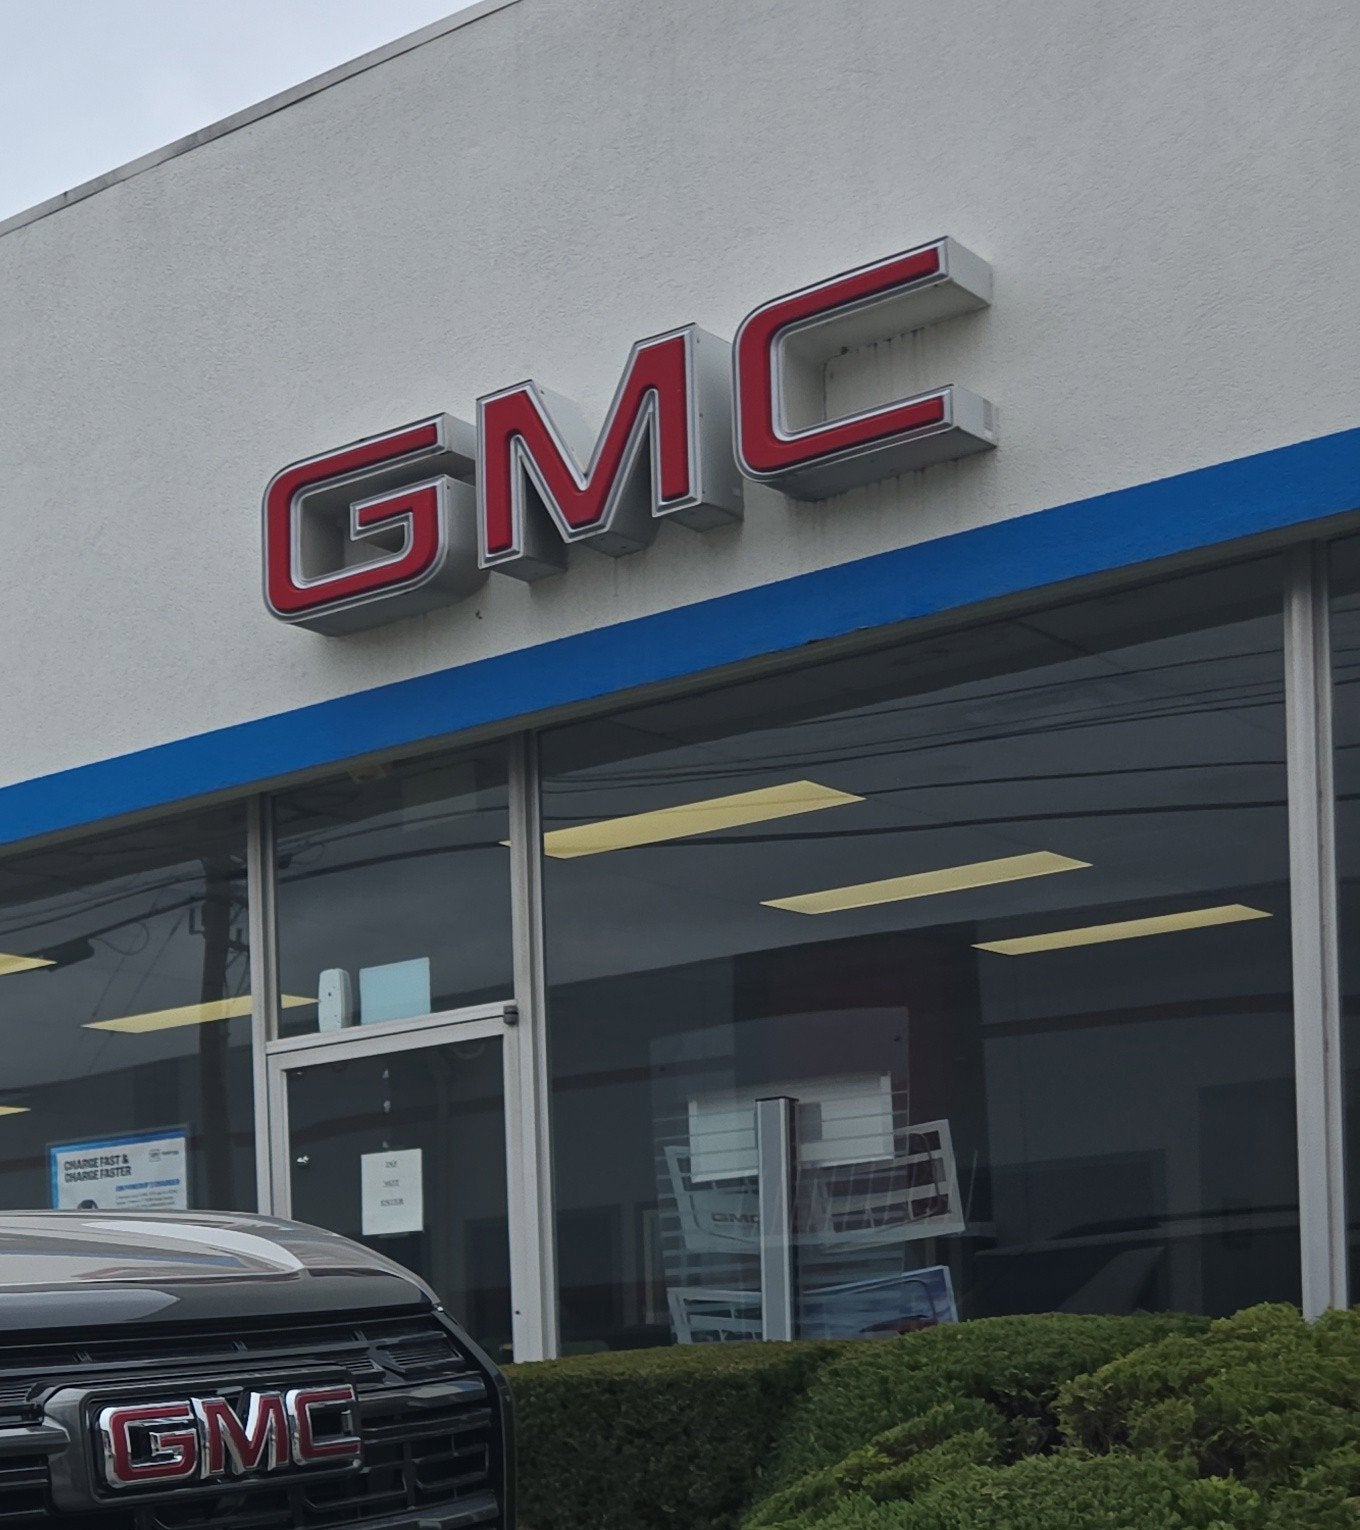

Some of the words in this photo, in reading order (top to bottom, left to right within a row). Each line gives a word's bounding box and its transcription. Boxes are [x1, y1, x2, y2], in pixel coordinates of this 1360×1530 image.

[262, 235, 997, 636] GMC
[64, 1158, 99, 1172] CHARGE
[100, 1155, 120, 1167] FAST
[122, 1153, 130, 1165] &
[64, 1169, 99, 1183] CHARGE
[100, 1166, 132, 1180] FASTER
[98, 1384, 362, 1490] GMC
